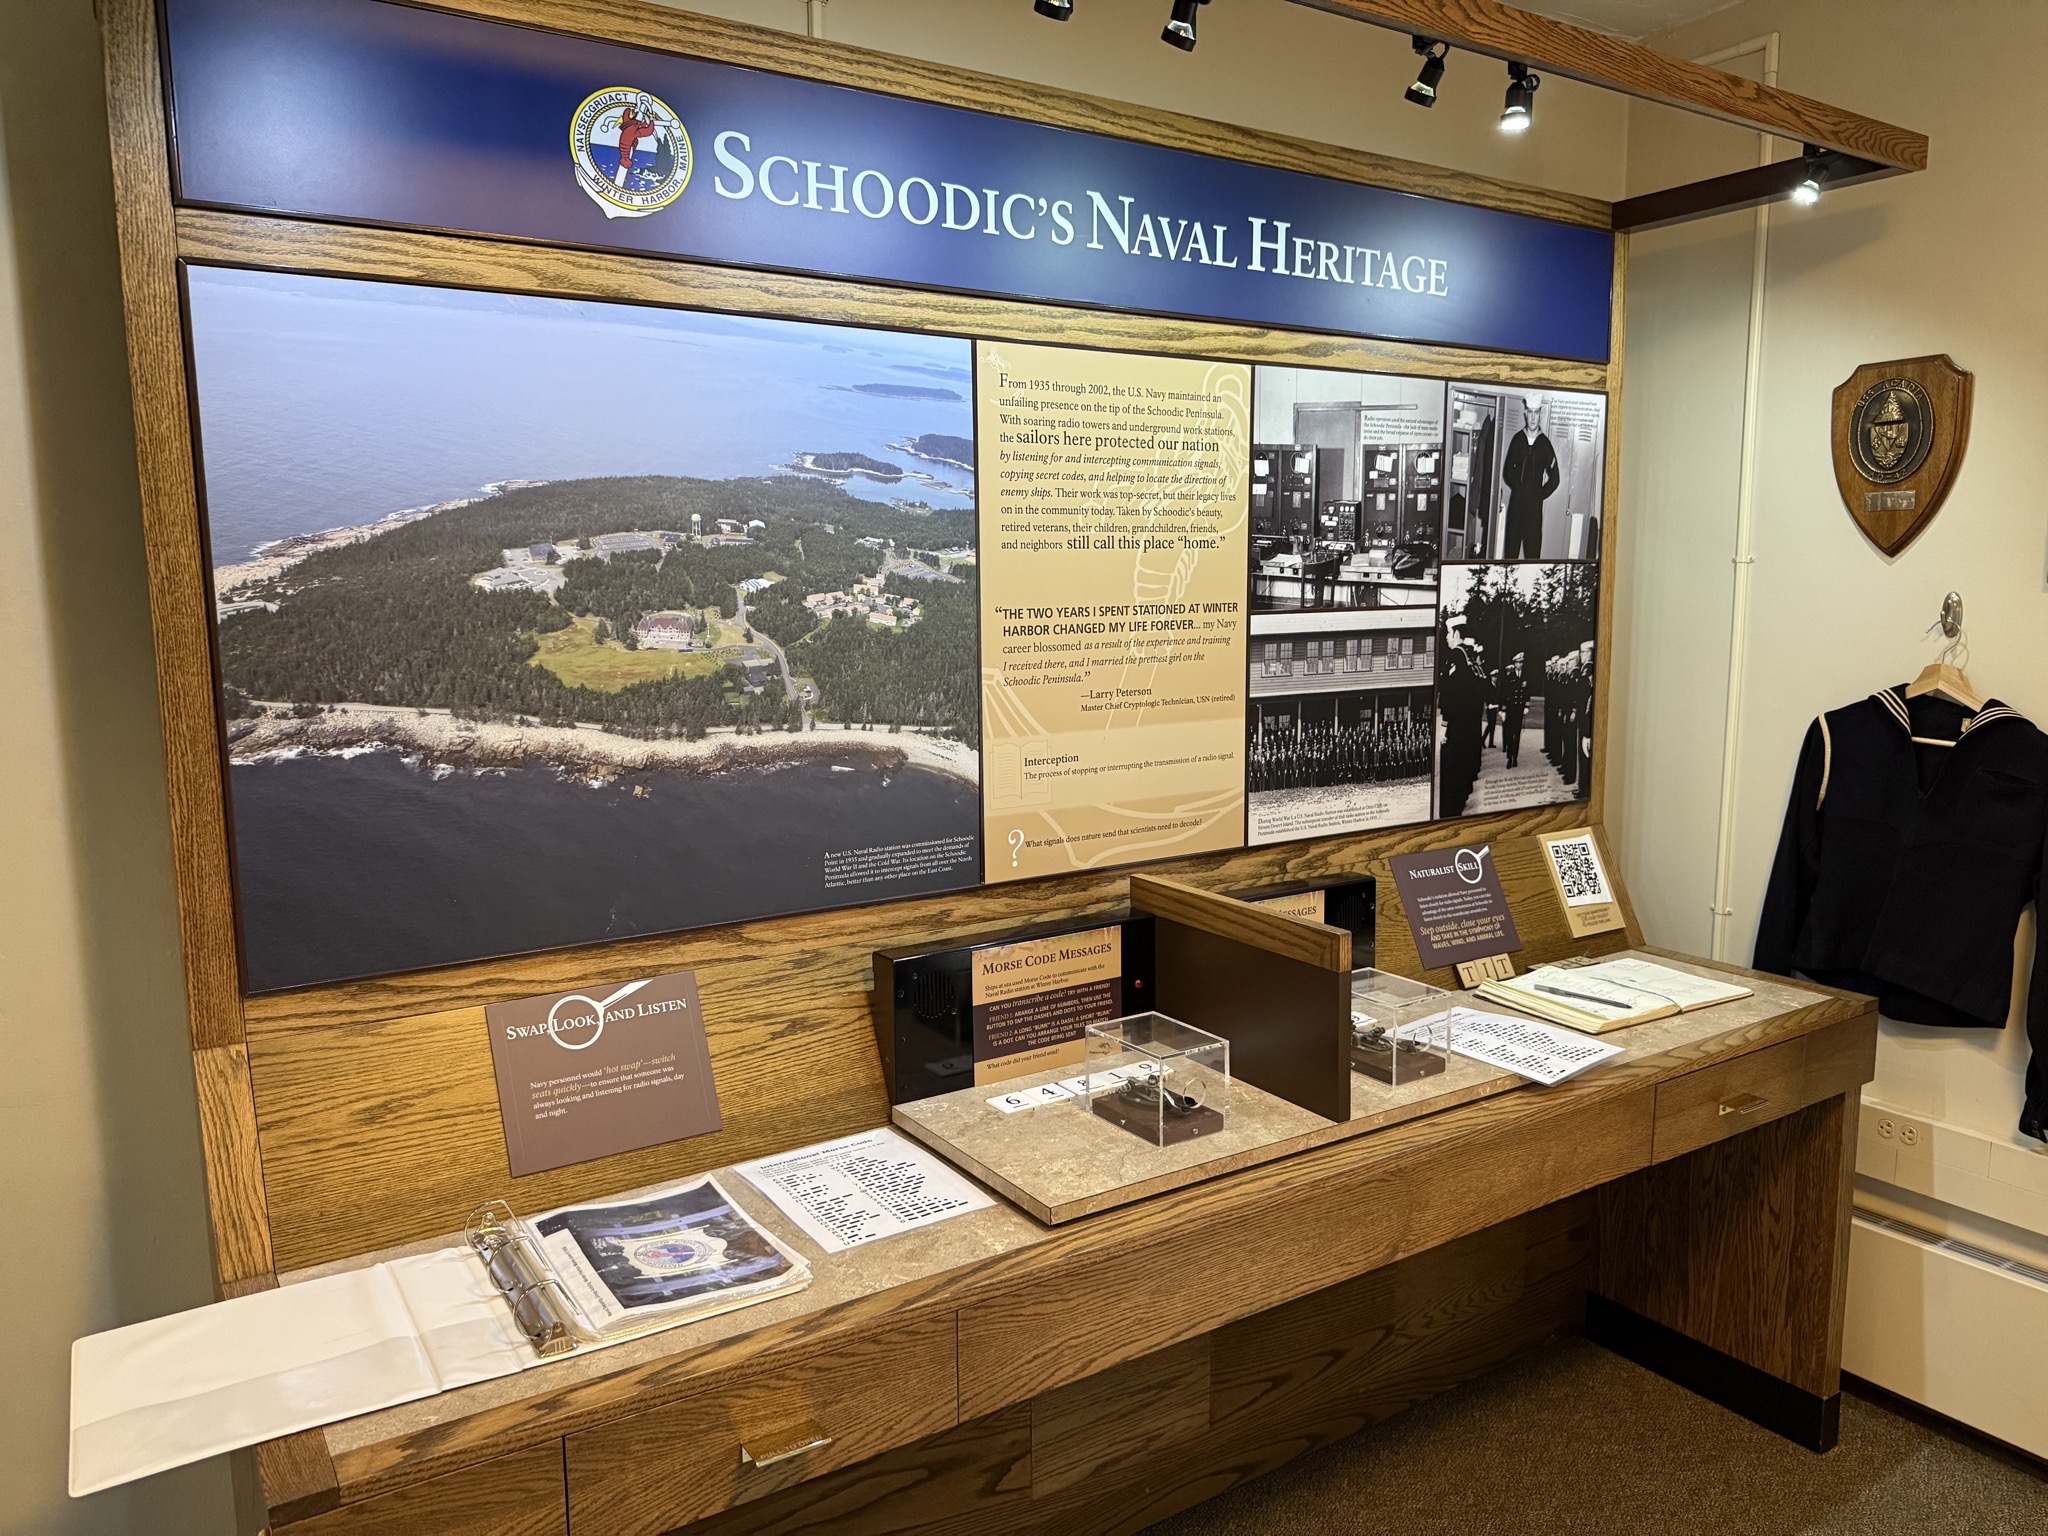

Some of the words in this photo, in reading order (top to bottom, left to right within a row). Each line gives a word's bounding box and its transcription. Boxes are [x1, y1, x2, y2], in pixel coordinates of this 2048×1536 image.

[576, 92, 629, 152] NAVSECGRUACT
[592, 174, 634, 204] WINTER
[641, 178, 683, 205] HARBOR,
[675, 134, 688, 171] MAINE
[712, 130, 1076, 246] SCHOODIC’S
[1086, 190, 1240, 268] NAVAL
[1246, 217, 1450, 297] HERITAGE
[999, 372, 1027, 389] From
[1029, 379, 1050, 391] 1935
[1051, 380, 1086, 396] through
[1088, 383, 1111, 397] 2002,
[1112, 385, 1126, 397] the
[1127, 386, 1144, 398] U.S.
[1145, 387, 1167, 402] Navy
[1167, 390, 1211, 402] maintained
[1212, 395, 1222, 403] an
[1882, 379, 1924, 401] ACADIA
[998, 397, 1039, 411] unfailing
[1040, 401, 1079, 412] presence
[1080, 403, 1092, 412] on
[1093, 402, 1107, 413] the
[1108, 403, 1120, 416] tip
[1121, 403, 1131, 414] of
[1132, 404, 1146, 415] the
[1146, 405, 1184, 417] Schoodic
[1185, 407, 1224, 420] Peninsula.
[999, 414, 1021, 425] With
[1023, 416, 1056, 430] soaring
[1057, 417, 1080, 429] radio
[1081, 420, 1111, 430] towers
[1111, 420, 1127, 431] and
[1128, 421, 1181, 436] underground
[1182, 424, 1203, 436] work
[1204, 425, 1238, 438] stations,
[999, 431, 1014, 443] the
[1016, 430, 1060, 445] sailors
[1063, 431, 1092, 447] here
[1094, 435, 1155, 451] protected
[1157, 439, 1179, 450] our
[1181, 437, 1219, 452] nation
[1001, 538, 1018, 549] and
[1020, 539, 1063, 552] neighbors
[1066, 535, 1090, 549] still
[1093, 535, 1115, 549] call
[1117, 535, 1141, 549] this
[1142, 535, 1175, 553] place
[1177, 535, 1226, 549] “home.”
[994, 607, 1024, 620] “THE
[1026, 607, 1053, 619] TWO
[1056, 606, 1090, 618] YEARS
[1093, 606, 1096, 617] I
[1098, 605, 1130, 617] SPENT
[1132, 603, 1186, 616] STATIONED
[1187, 603, 1201, 614] AT
[1202, 602, 1238, 613] WINTER
[1003, 624, 1050, 637] HARBOR
[1052, 622, 1106, 635] CHANGED
[1108, 621, 1126, 633] MY
[1128, 620, 1148, 632] LIFE
[1202, 621, 1215, 632] my
[1216, 618, 1237, 631] Navy
[1002, 675, 1041, 687] Schoodic
[1042, 670, 1091, 685] Peninsula.”
[1080, 689, 1114, 701] —Larry
[1115, 688, 1152, 697] Peterson
[1024, 753, 1079, 767] Interception
[1024, 839, 1043, 848] What
[1043, 836, 1065, 848] signals
[1065, 835, 1081, 843] does
[1081, 832, 1101, 841] nature
[1101, 829, 1117, 838] send
[1117, 828, 1129, 836] that
[1129, 825, 1157, 835] scientists
[1157, 821, 1172, 831] need
[1179, 818, 1203, 828] decode?
[824, 851, 830, 859] A
[842, 849, 853, 857] U.S.
[853, 847, 868, 855] Naval
[911, 837, 945, 848] commissioned
[953, 834, 975, 842] Schoodic
[1409, 865, 1455, 880] NATURALIST
[1457, 861, 1480, 872] SKILL
[1419, 926, 1435, 936] Step
[1434, 920, 1461, 933] outside,
[1460, 918, 1476, 929] close
[1475, 916, 1491, 927] your
[1491, 914, 1505, 924] eyes
[982, 959, 1023, 976] MORSE
[1024, 952, 1056, 967] CODE
[1058, 942, 1112, 961] MESSAGES
[984, 984, 998, 992] Ships
[1011, 978, 1023, 986] used
[1023, 976, 1039, 984] Morse
[1038, 973, 1052, 981] Code
[1057, 967, 1087, 978] communicate
[984, 989, 999, 999] Naval
[999, 988, 1014, 996] Radio
[1051, 977, 1069, 985] Harbor
[506, 1023, 550, 1040] SWAP,
[553, 1015, 600, 1032] LOOK,
[605, 1008, 635, 1023] AND
[637, 999, 687, 1017] LISTEN
[529, 1081, 547, 1089] Navy
[548, 1072, 581, 1088] personnel
[581, 1068, 603, 1079] would
[531, 1089, 551, 1100] seats
[598, 1077, 619, 1086] ensure
[619, 1073, 633, 1081] that
[633, 1068, 661, 1079] someone
[661, 1065, 674, 1073] was
[533, 1100, 556, 1109] always
[555, 1094, 582, 1105] looking
[581, 1090, 595, 1100] and
[594, 1086, 623, 1097] listening
[622, 1083, 632, 1091] for
[633, 1080, 650, 1089] radio
[650, 1075, 673, 1086] signals,
[673, 1073, 685, 1081] day
[1005, 1095, 1021, 1105] 6
[534, 1110, 548, 1120] and
[548, 1107, 568, 1117] night.
